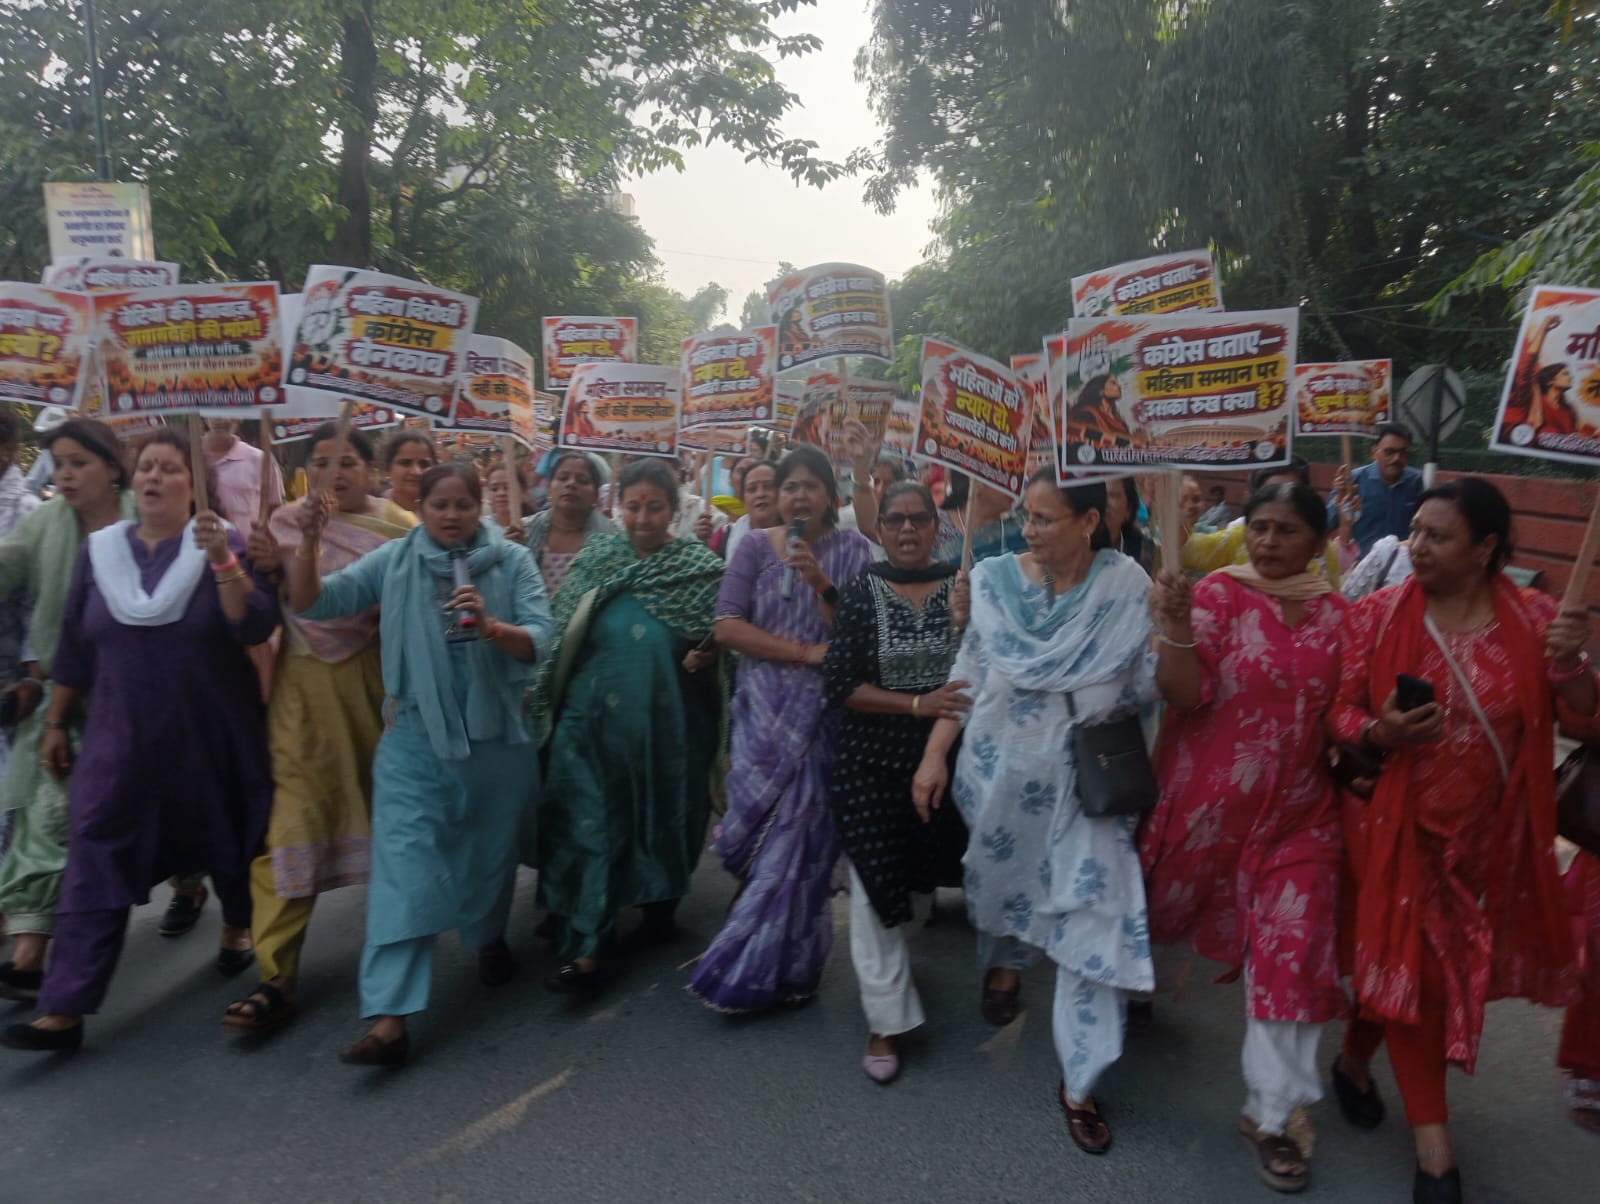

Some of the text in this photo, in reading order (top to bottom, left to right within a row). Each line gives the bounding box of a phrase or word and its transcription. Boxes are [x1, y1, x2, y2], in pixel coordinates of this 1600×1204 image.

[1116, 275, 1161, 300] कांग्रेस
[1158, 288, 1194, 307] सम्मान
[1196, 284, 1210, 296] पर
[167, 300, 194, 320] की
[351, 291, 462, 327] महिला विरोधी
[199, 319, 221, 339] की
[365, 318, 437, 347] कांग्रेस
[350, 336, 448, 375] बेनकाब
[1142, 335, 1205, 367] कांग्रेस
[585, 377, 621, 399] महिला
[948, 363, 1005, 399] महिलाओं
[1003, 386, 1022, 413] को
[1146, 359, 1280, 393] महिला सम्मान पर
[955, 387, 992, 424] न्याय
[1142, 397, 1190, 419] उसका
[1190, 394, 1222, 413] रुख
[1222, 389, 1256, 410] क्या
